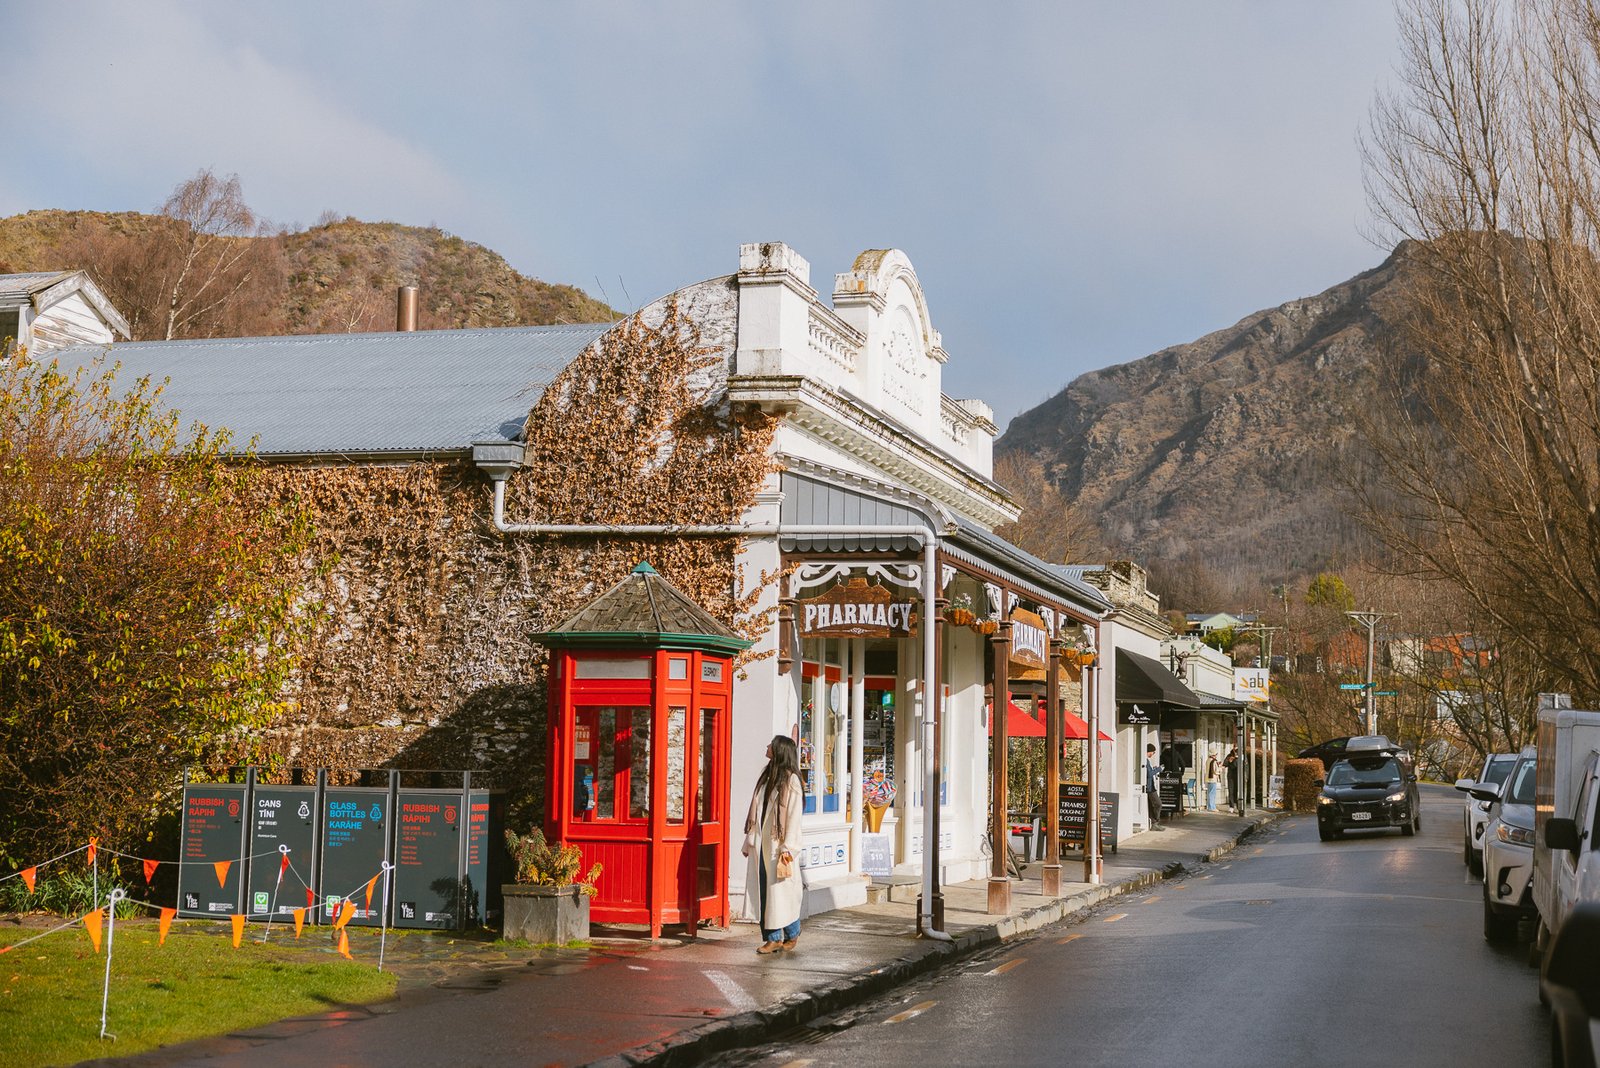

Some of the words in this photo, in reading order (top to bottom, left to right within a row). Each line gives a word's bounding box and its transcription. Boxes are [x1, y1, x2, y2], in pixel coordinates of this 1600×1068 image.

[804, 603, 912, 632] PHARMACY
[1249, 672, 1264, 688] ab
[189, 798, 225, 807] RUBBISH
[259, 799, 282, 808] CANS
[330, 802, 357, 811] GLASS
[1061, 801, 1087, 809] TIRAMISU
[402, 804, 440, 813] RUBBISH
[330, 810, 366, 819] BOTTLES
